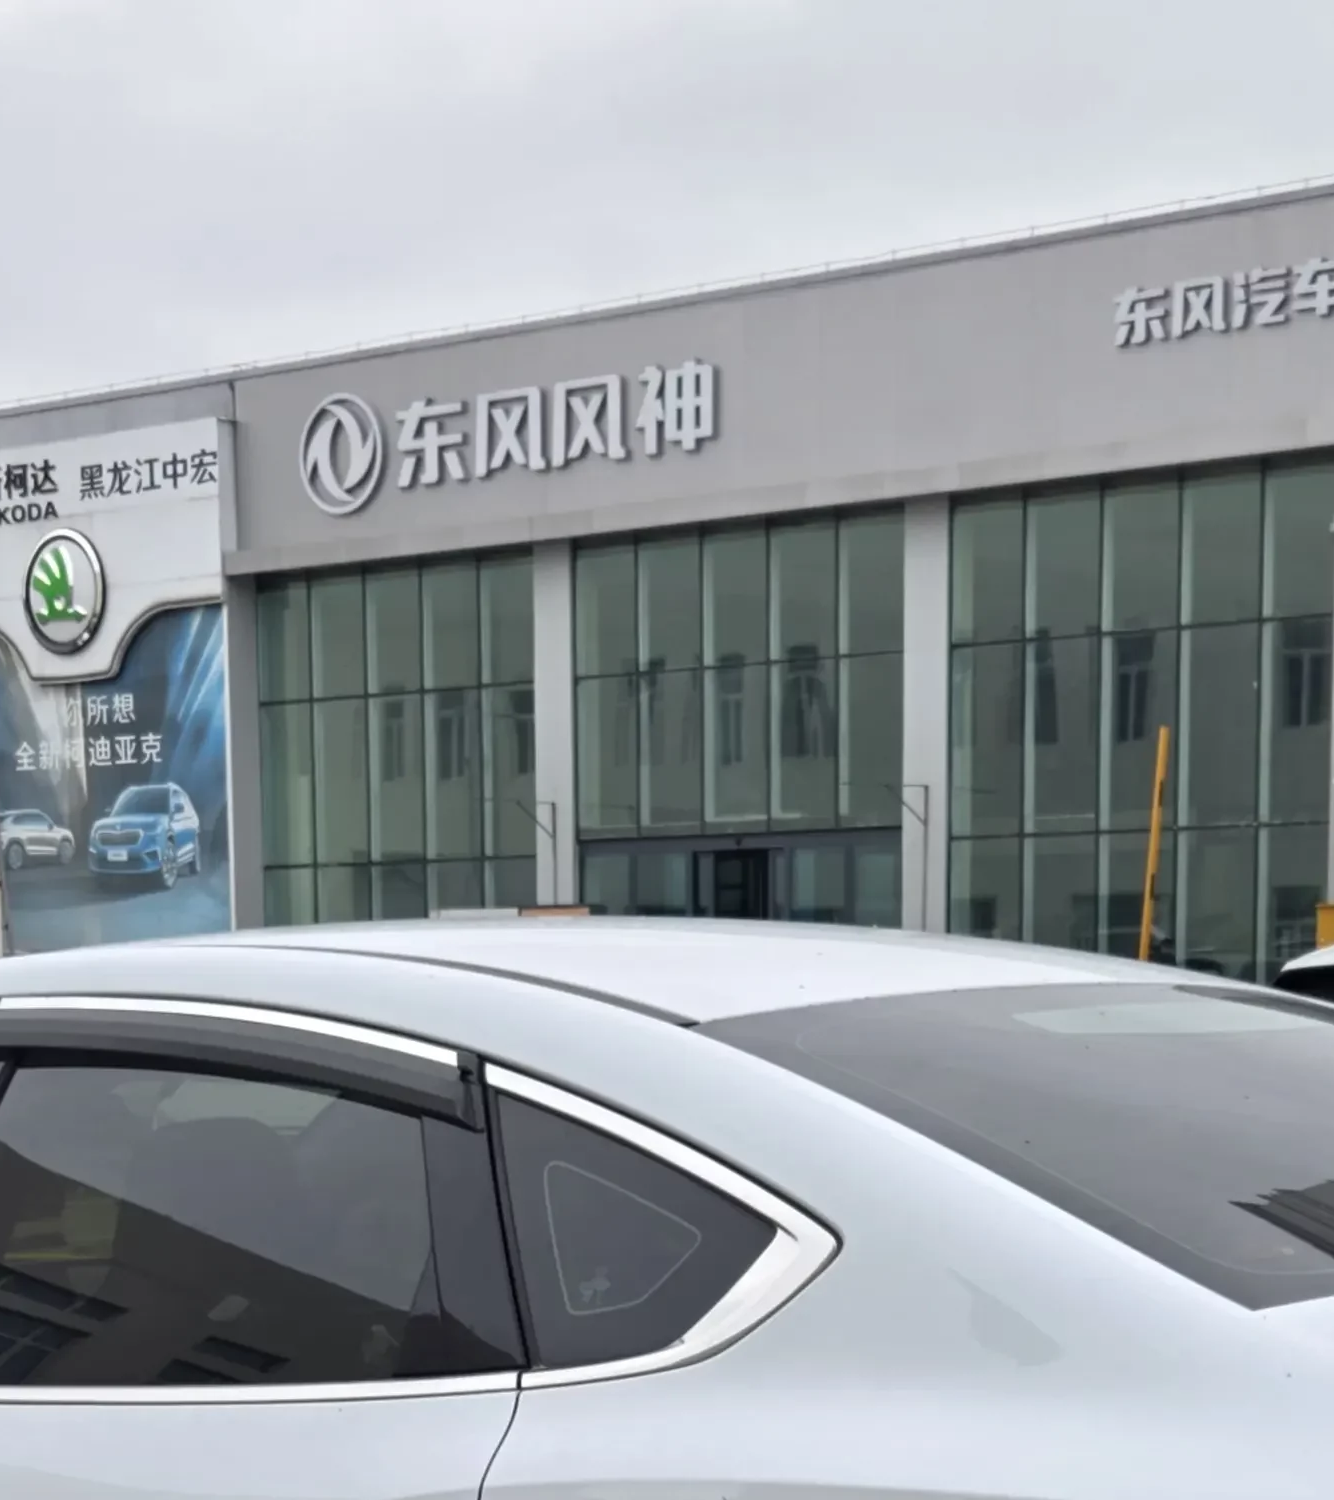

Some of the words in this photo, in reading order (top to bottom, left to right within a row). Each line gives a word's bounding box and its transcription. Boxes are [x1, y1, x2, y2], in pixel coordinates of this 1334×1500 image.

[395, 359, 717, 489] 东风风神
[78, 448, 219, 501] 黑龙江中宏
